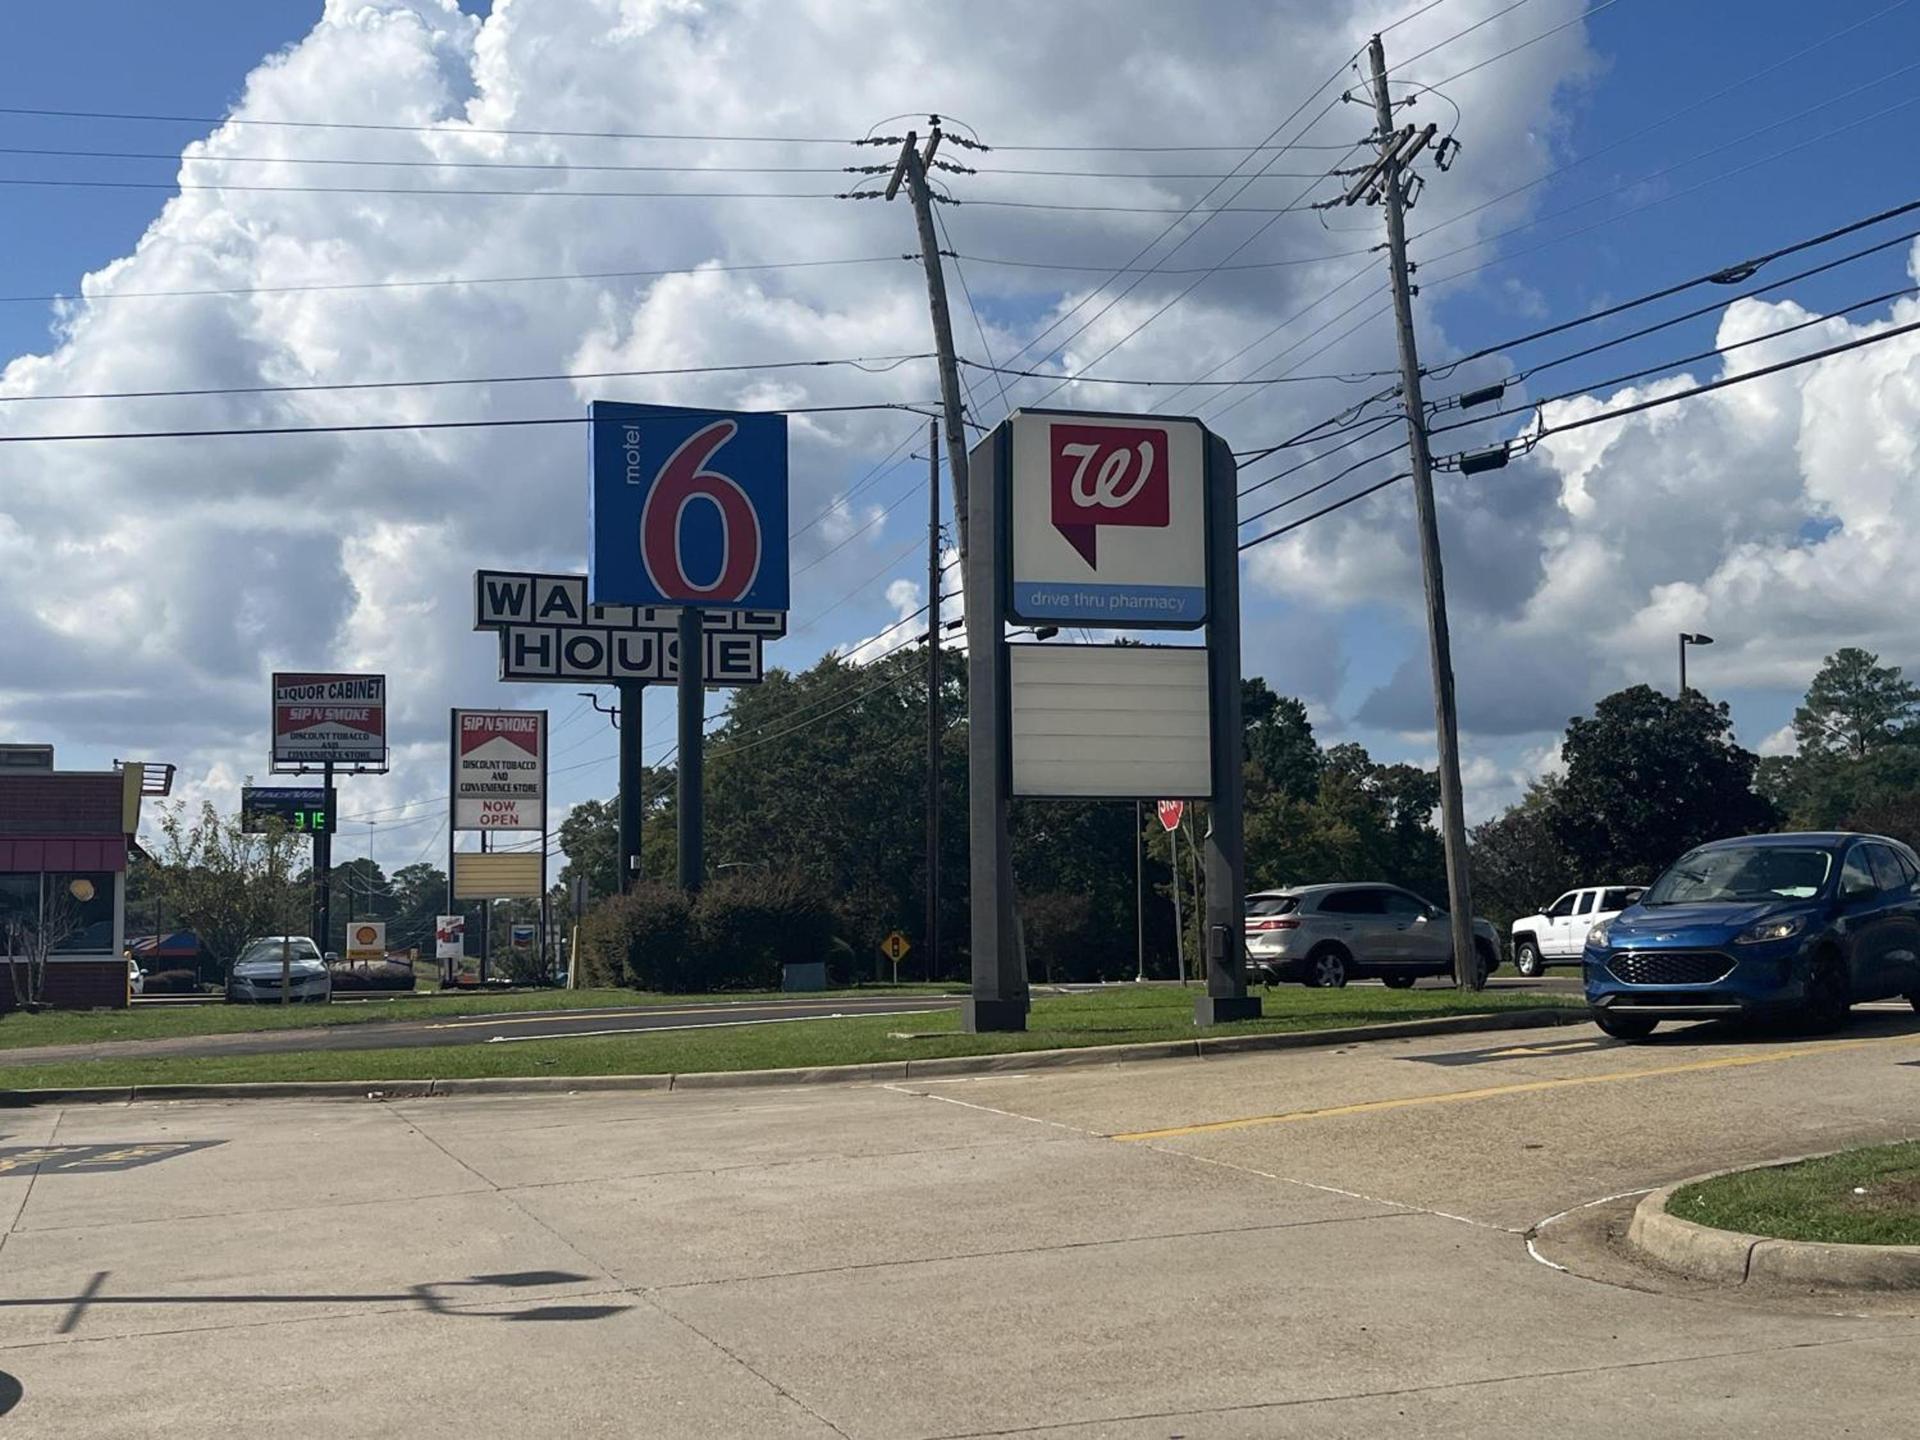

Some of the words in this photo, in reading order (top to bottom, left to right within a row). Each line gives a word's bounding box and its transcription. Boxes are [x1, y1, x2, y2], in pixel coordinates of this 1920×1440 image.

[622, 425, 640, 485] motel
[640, 418, 762, 602] 6
[1031, 591, 1069, 607] drive
[1074, 592, 1105, 608] thru
[1109, 593, 1186, 611] pharmacy
[276, 685, 325, 701] LIQUOR
[328, 679, 382, 700] CABINET
[289, 707, 312, 720] SIP
[324, 708, 370, 721] SMOKE
[463, 716, 484, 731] SIP
[495, 717, 536, 732] SMOKE
[290, 732, 330, 740] DISCOUNT
[332, 732, 370, 740] TOBACCO
[462, 760, 500, 769] DISCOUNT
[501, 760, 537, 770] TOBACCO
[491, 772, 509, 781] AND
[460, 783, 513, 792] CONVENIENCE
[513, 783, 537, 793] STORE
[482, 801, 516, 812] NOW
[480, 814, 519, 826] OPEN
